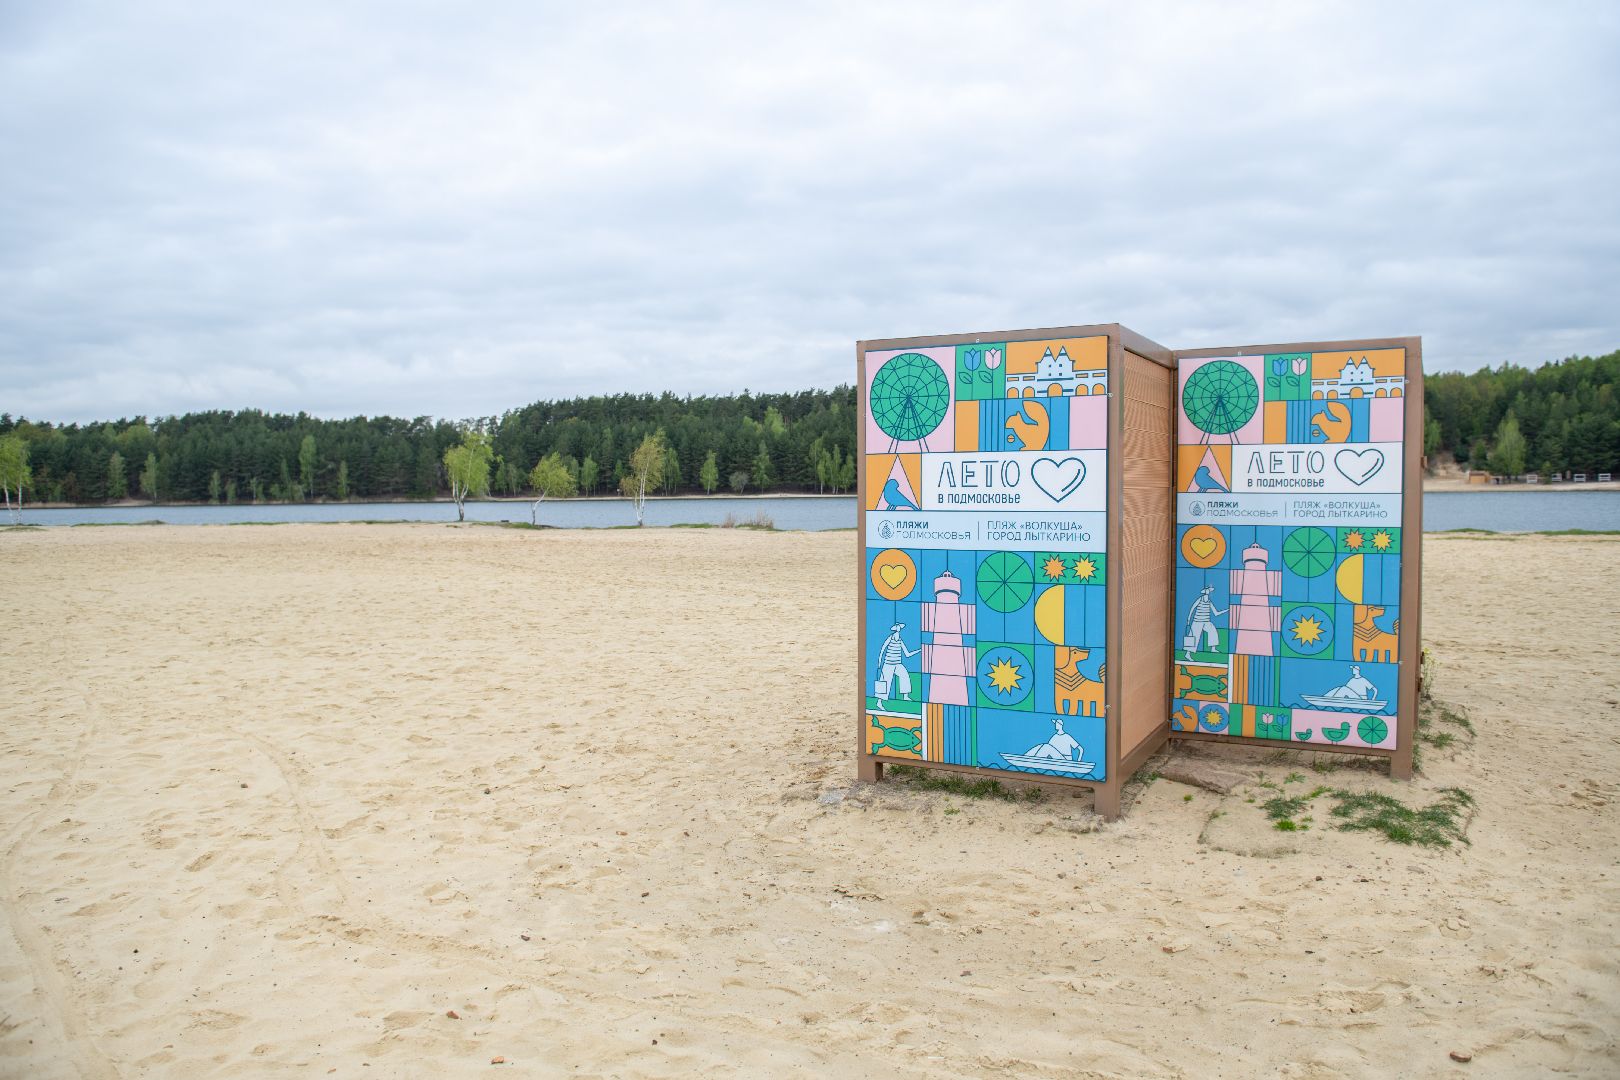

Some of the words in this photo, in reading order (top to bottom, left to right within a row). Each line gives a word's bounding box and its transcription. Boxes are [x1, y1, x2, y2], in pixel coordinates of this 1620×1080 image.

[1247, 450, 1325, 474] ЛЕТО
[937, 460, 1021, 488] ЛЕТО
[1293, 500, 1321, 509] ПЛЯЖ
[1323, 501, 1381, 509] «ВОЛКУША»
[1206, 509, 1278, 518] ПОДМОСКОВЬЯ
[1293, 509, 1325, 518] ГОРОД
[1327, 510, 1388, 519] ЛЫТКАРИНО
[896, 520, 929, 529] ПЛЯЖИ
[987, 520, 1017, 530] ПЛЯЖ
[1020, 521, 1083, 531] «ВОЛКУША»
[987, 531, 1022, 541] ГОРОД
[1024, 532, 1091, 542] ЛЫТКАРИНО
